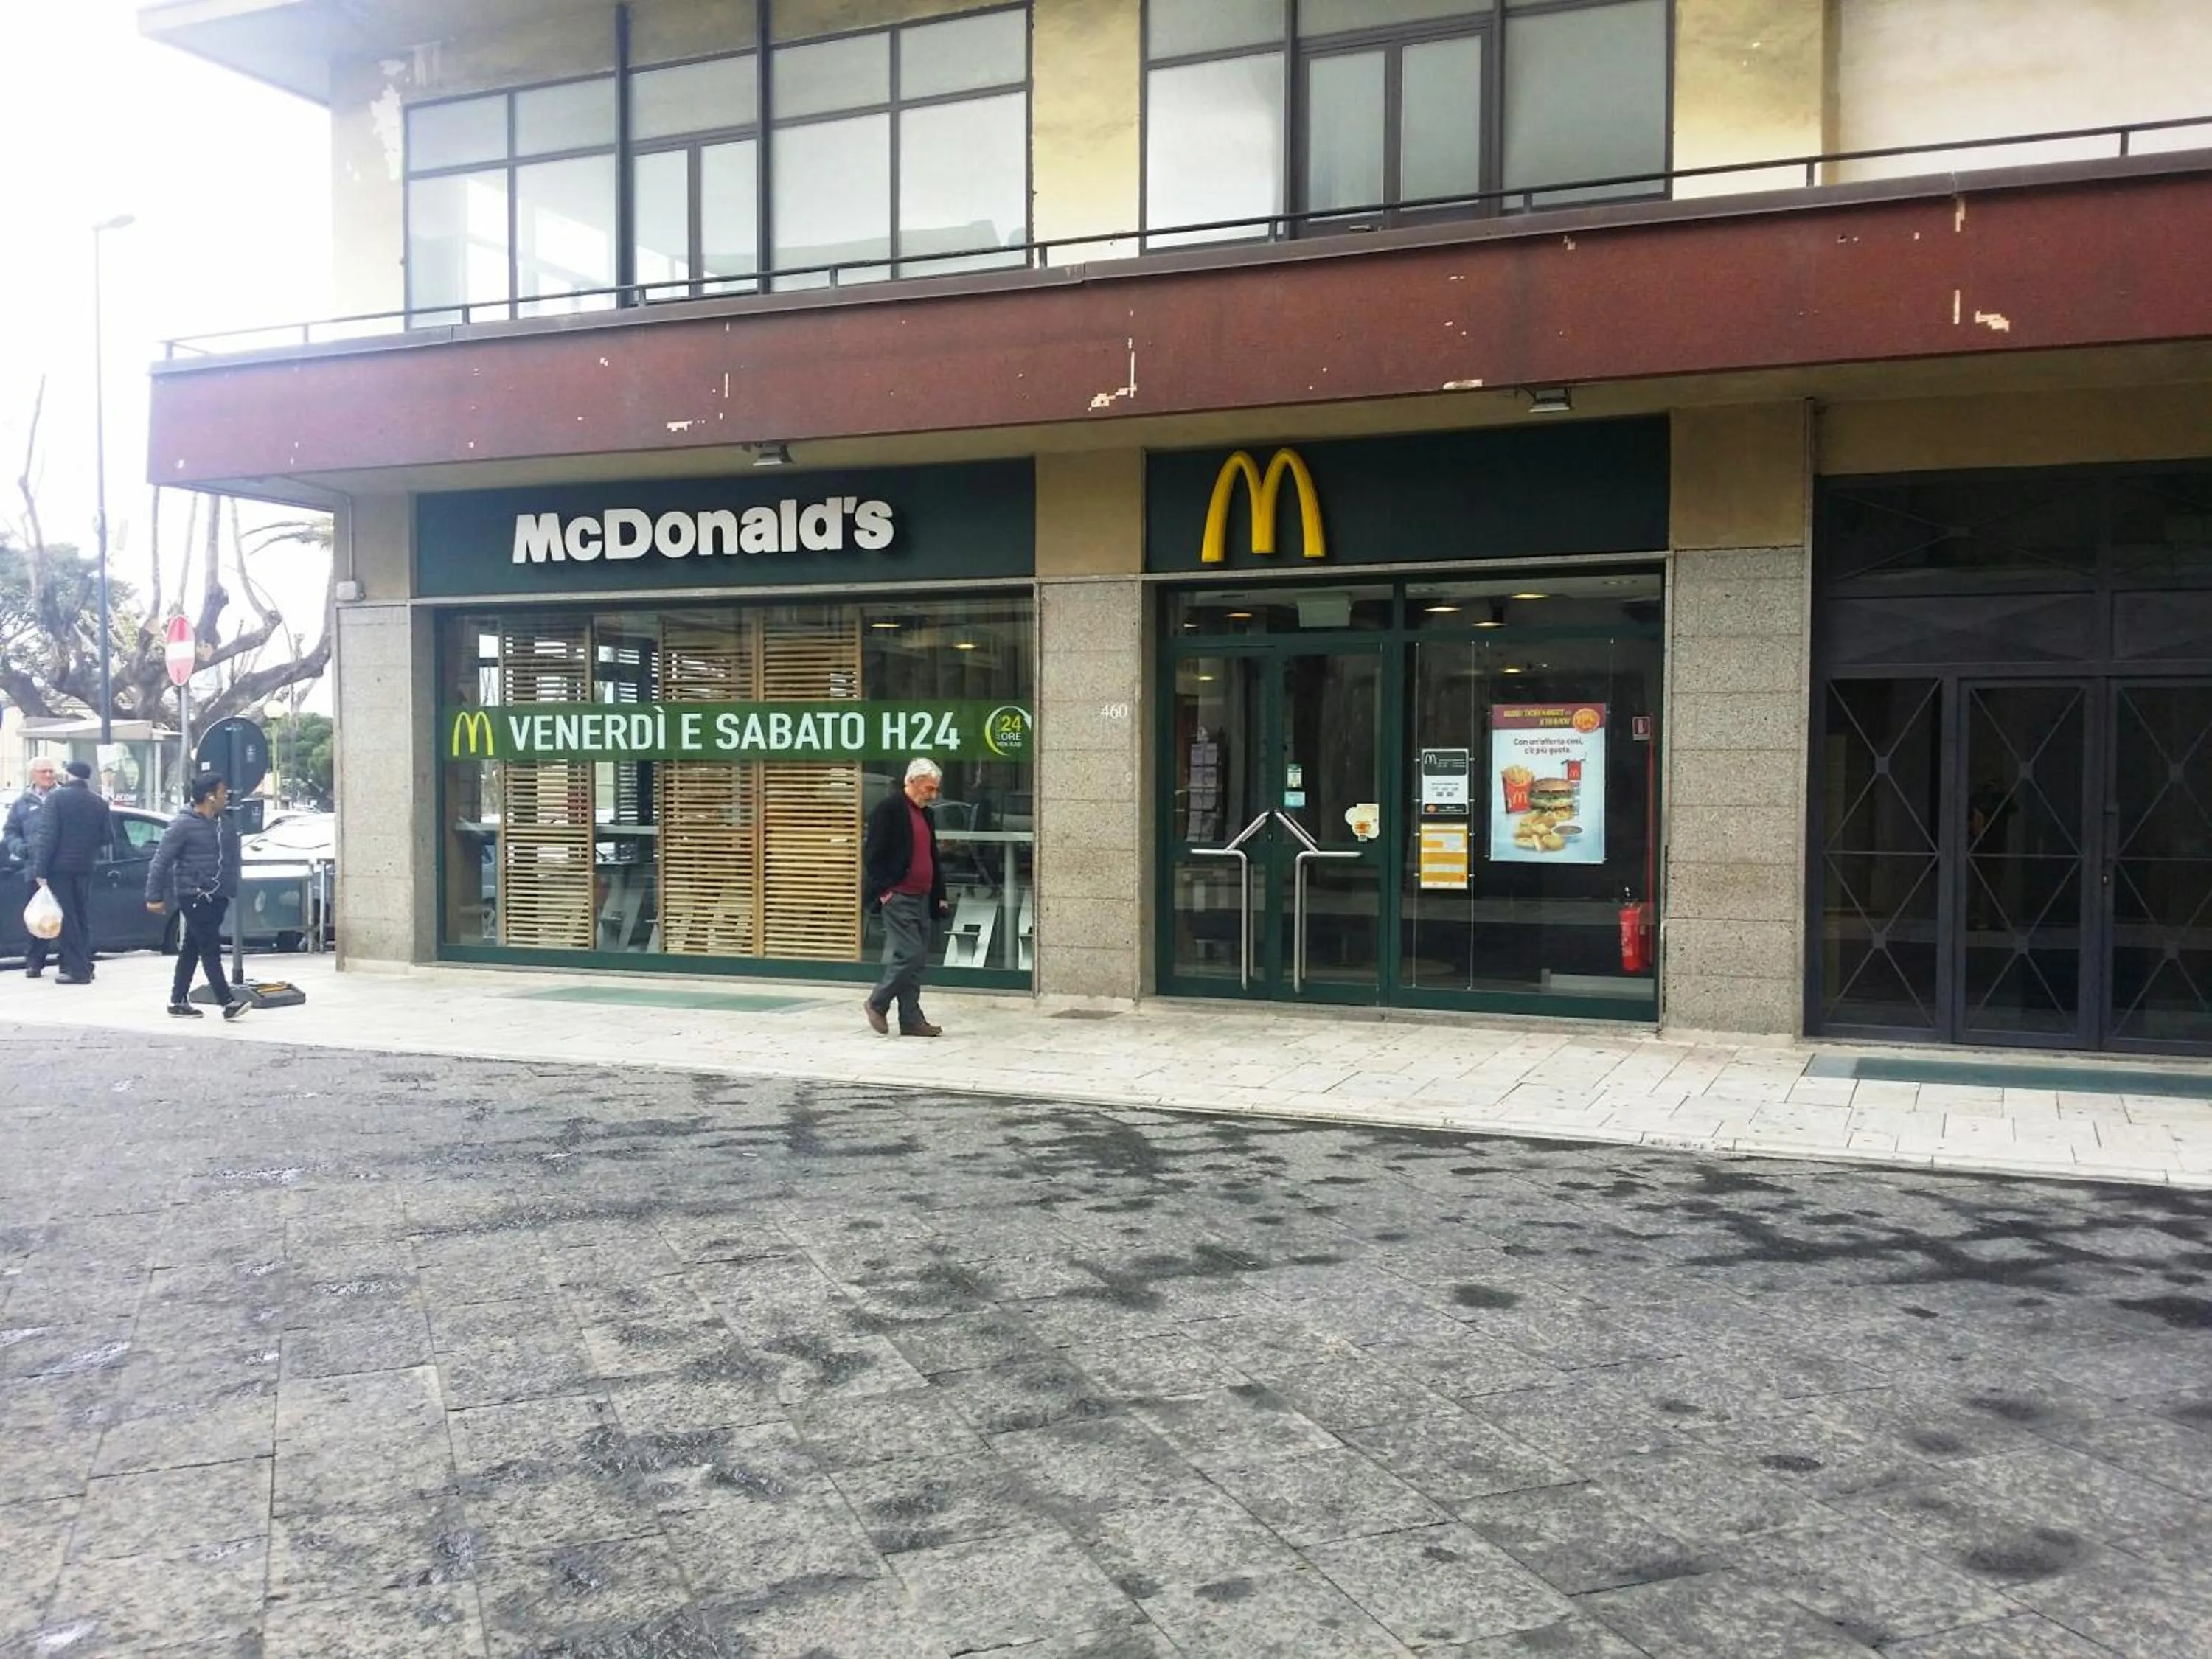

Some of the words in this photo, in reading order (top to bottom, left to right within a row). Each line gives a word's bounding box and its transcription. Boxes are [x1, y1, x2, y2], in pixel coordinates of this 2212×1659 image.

[512, 496, 894, 563] McDonald's
[1100, 703, 1128, 720] 460
[508, 706, 666, 751] VENERDÌ
[681, 713, 703, 751] E
[715, 712, 865, 751] SABATO
[882, 712, 961, 751] H24
[1001, 714, 1022, 732] 24
[1001, 732, 1022, 741] ORE
